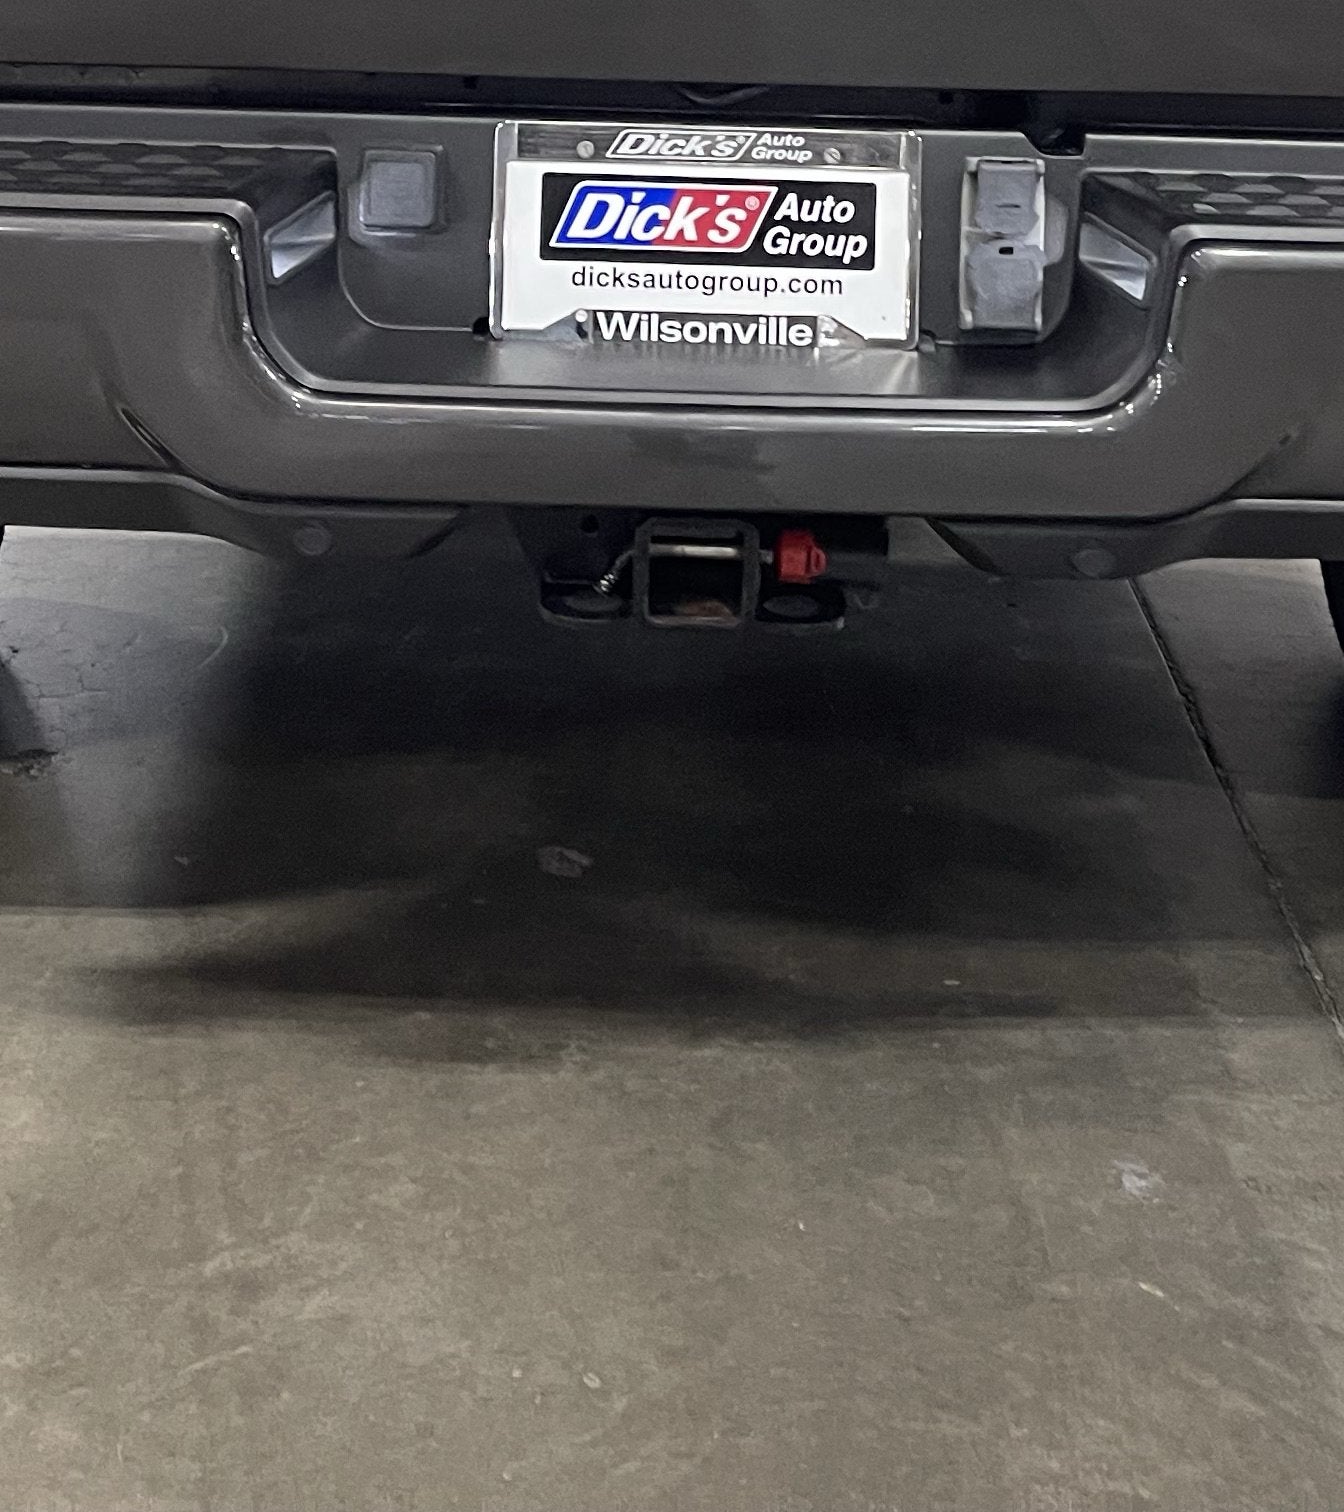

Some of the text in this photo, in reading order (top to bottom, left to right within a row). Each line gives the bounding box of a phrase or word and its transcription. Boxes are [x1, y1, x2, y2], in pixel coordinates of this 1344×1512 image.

[751, 146, 813, 164] Group
[757, 133, 806, 148] Auto
[773, 192, 856, 225] Auto
[763, 226, 869, 265] Group
[571, 265, 844, 297] dicksautogroup.com
[596, 311, 814, 348] Wilsonville
